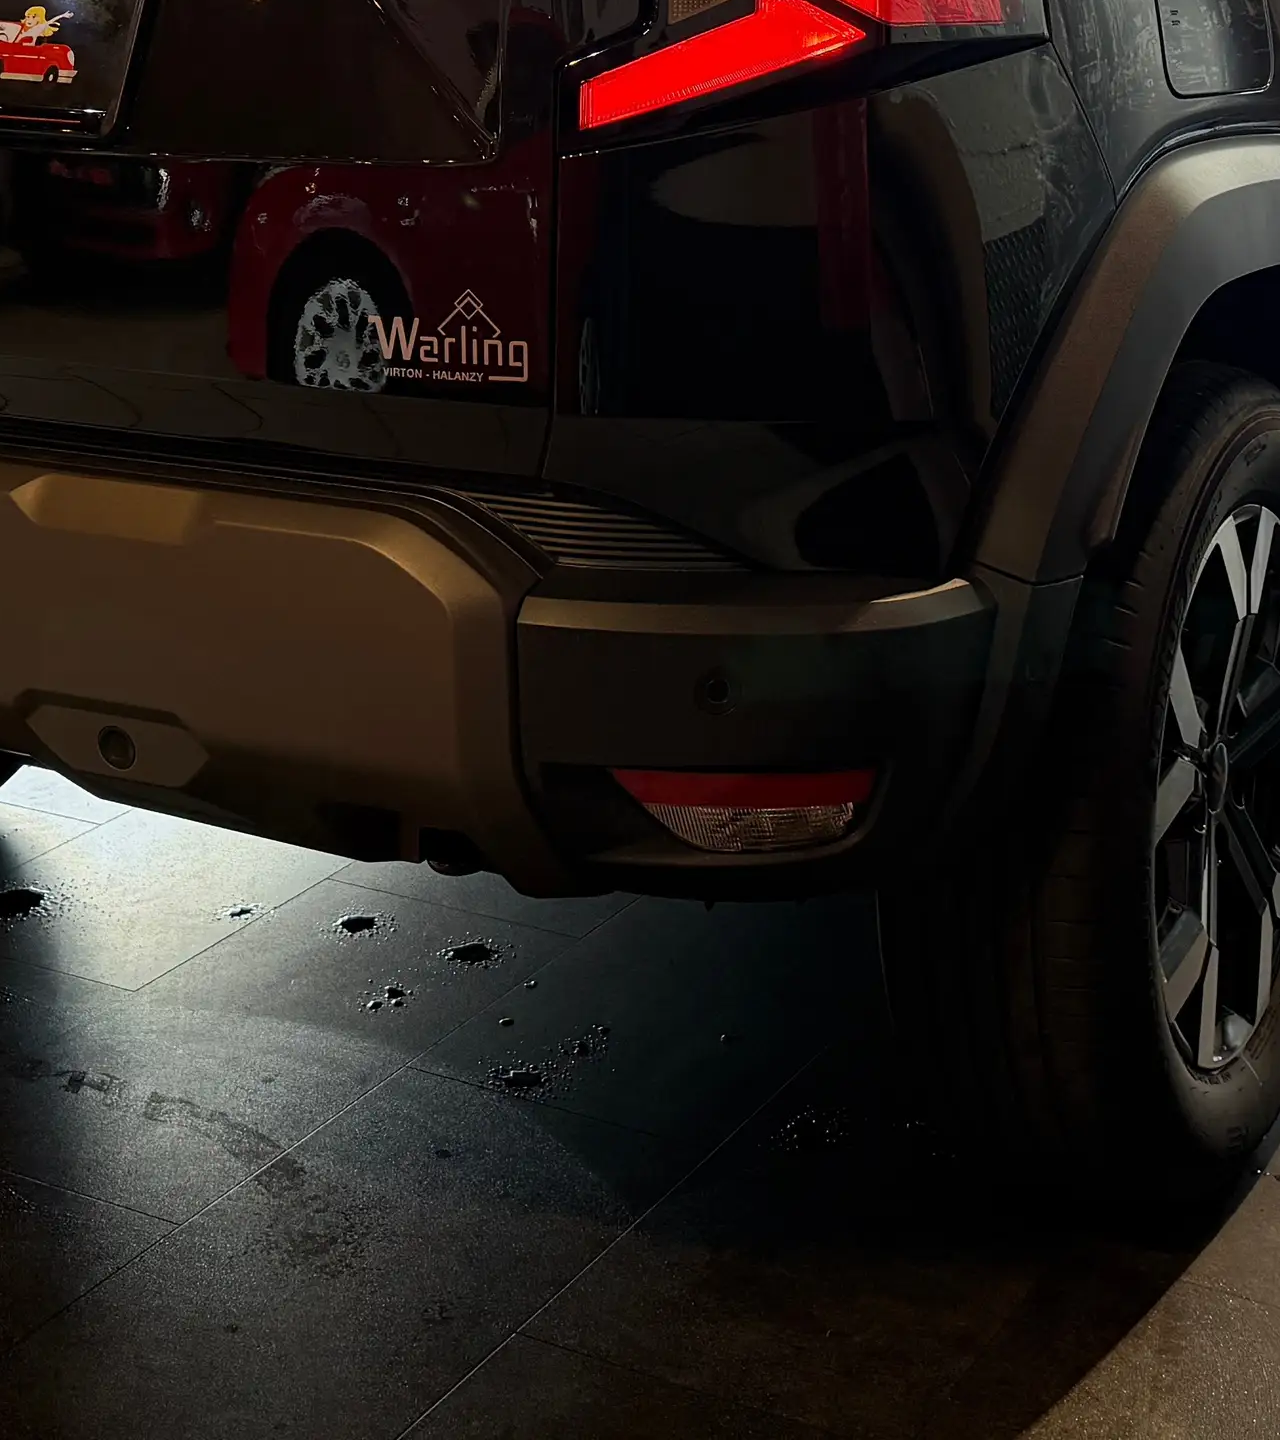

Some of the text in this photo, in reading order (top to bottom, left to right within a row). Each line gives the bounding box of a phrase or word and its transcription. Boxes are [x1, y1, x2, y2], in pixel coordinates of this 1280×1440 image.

[367, 314, 529, 383] Warling
[383, 367, 423, 379] VIRTON
[432, 370, 484, 383] HALANZY
